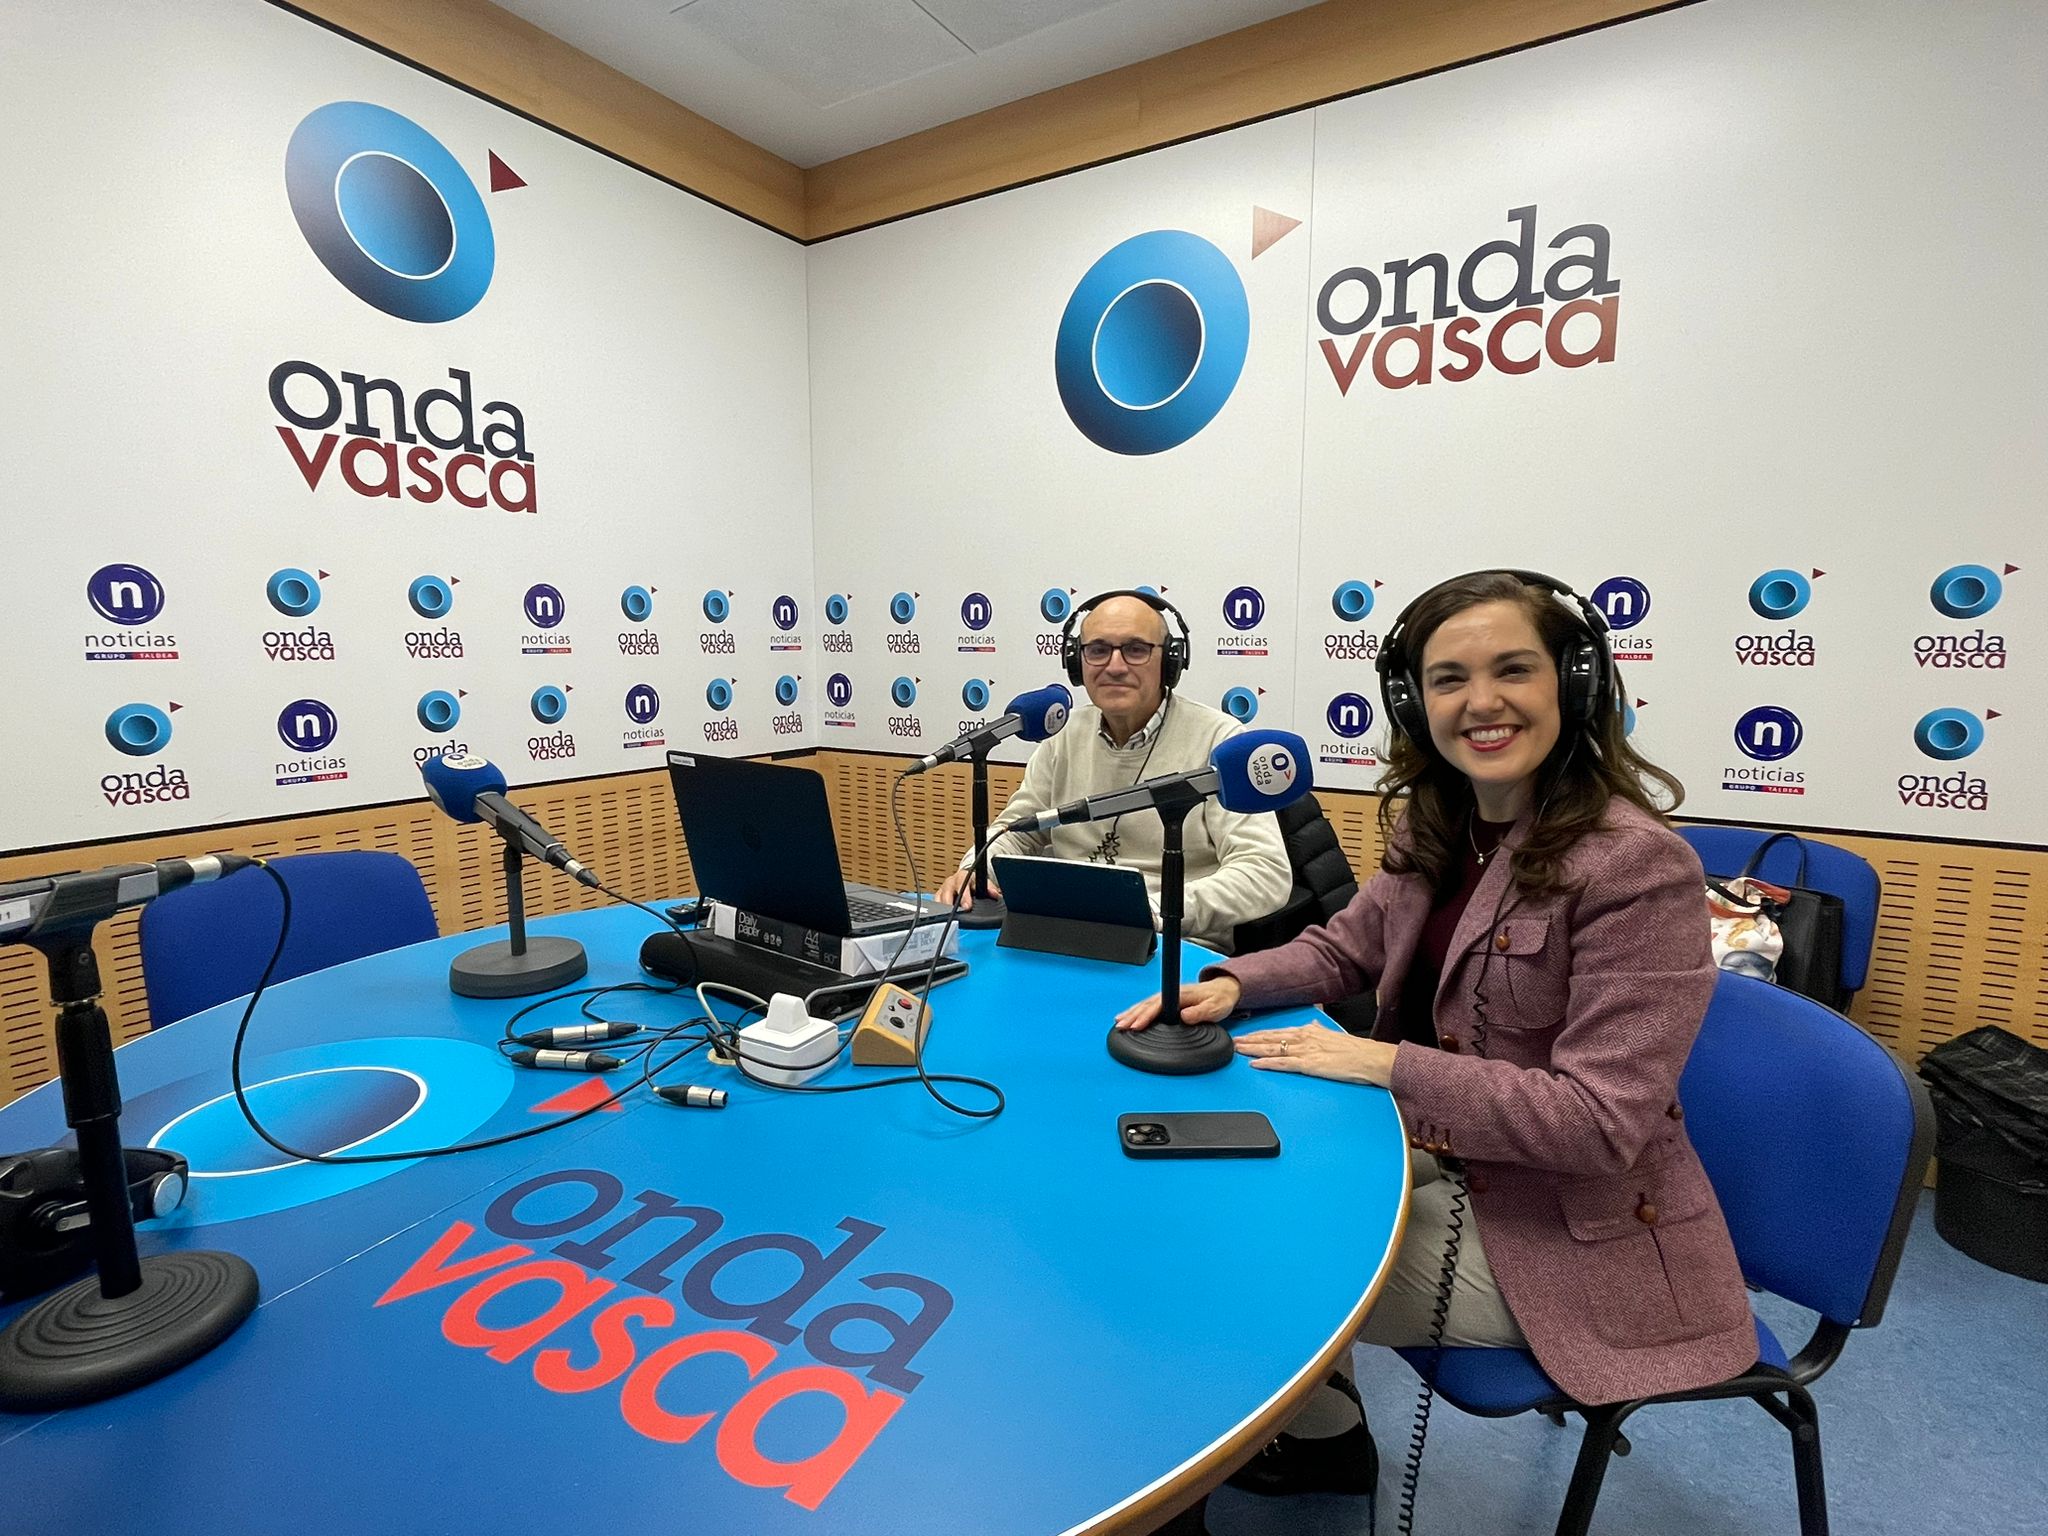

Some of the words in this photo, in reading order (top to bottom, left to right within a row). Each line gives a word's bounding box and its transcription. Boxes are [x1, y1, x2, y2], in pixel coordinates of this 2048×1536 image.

[1317, 204, 1620, 335] onda
[1318, 296, 1619, 398] vasca
[268, 360, 534, 462] onda
[275, 425, 537, 513] vasca
[110, 581, 143, 608] n
[536, 596, 553, 616] n
[1234, 598, 1252, 618] n
[1607, 592, 1632, 615] n
[85, 631, 176, 647] noticias
[263, 626, 333, 647] onda
[405, 627, 462, 646] onda
[521, 633, 571, 645] noticias
[618, 629, 658, 644] onda
[700, 630, 734, 644] onda
[823, 630, 852, 644] onda
[887, 630, 919, 644] onda
[958, 634, 995, 645] noticias
[1036, 634, 1063, 646] on
[1217, 635, 1268, 647] noticias
[1324, 630, 1378, 648] onda
[1608, 634, 1653, 649] icias
[1735, 629, 1815, 651] onda
[1914, 629, 2006, 652] onda
[264, 647, 335, 661] vasca
[406, 645, 463, 659] vasca
[619, 643, 659, 655] vasca
[701, 643, 735, 654] vasca
[823, 643, 853, 652] vasca
[888, 643, 920, 653] vasca
[1036, 645, 1063, 655] vas
[1735, 650, 1815, 666] vasca
[1914, 652, 2006, 669] vasca
[635, 695, 650, 714] n
[772, 711, 802, 726] onda
[888, 714, 920, 728] onda
[1340, 705, 1359, 726] n
[295, 713, 321, 738] n
[703, 717, 737, 732] onda
[773, 723, 802, 735] vasca
[889, 726, 921, 737] vasca
[958, 718, 985, 732] ond
[527, 730, 575, 750] onda
[623, 727, 665, 740] noticias
[704, 730, 738, 742] vasca
[1753, 721, 1782, 746] n
[528, 746, 575, 761] vasca
[1320, 742, 1376, 756] noticias
[275, 756, 346, 774] noticias
[100, 764, 188, 792] onda
[1724, 766, 1805, 783] noticias
[1898, 771, 1988, 795] onda
[103, 784, 190, 807] vasca
[1898, 790, 1988, 811] vasca
[738, 911, 758, 928] Daily
[738, 923, 760, 937] paper
[484, 1169, 954, 1394] onda
[373, 1220, 906, 1512] vasca
